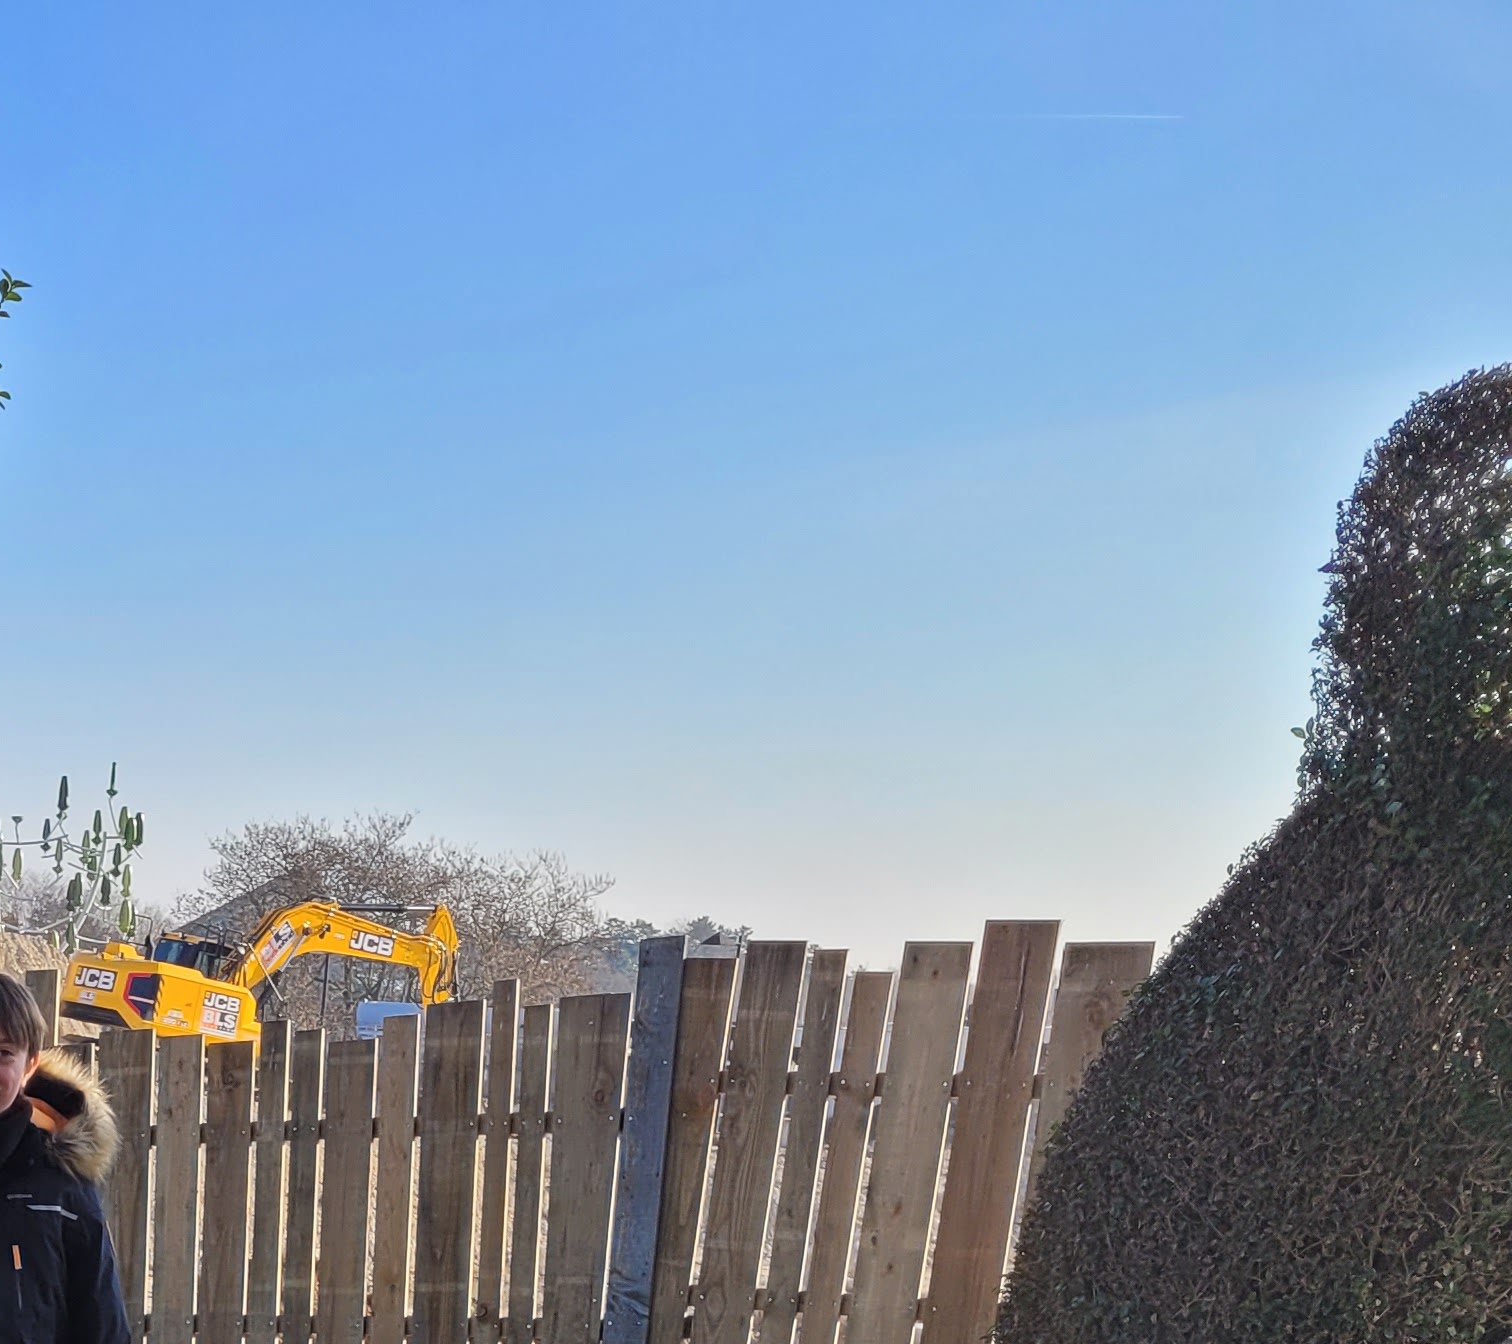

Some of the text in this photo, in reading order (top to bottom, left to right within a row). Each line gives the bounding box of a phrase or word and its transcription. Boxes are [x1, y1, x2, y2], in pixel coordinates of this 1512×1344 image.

[350, 931, 394, 956] JCB
[74, 967, 116, 990] JCB
[204, 992, 241, 1012] JCB
[202, 1009, 236, 1029] BLS
